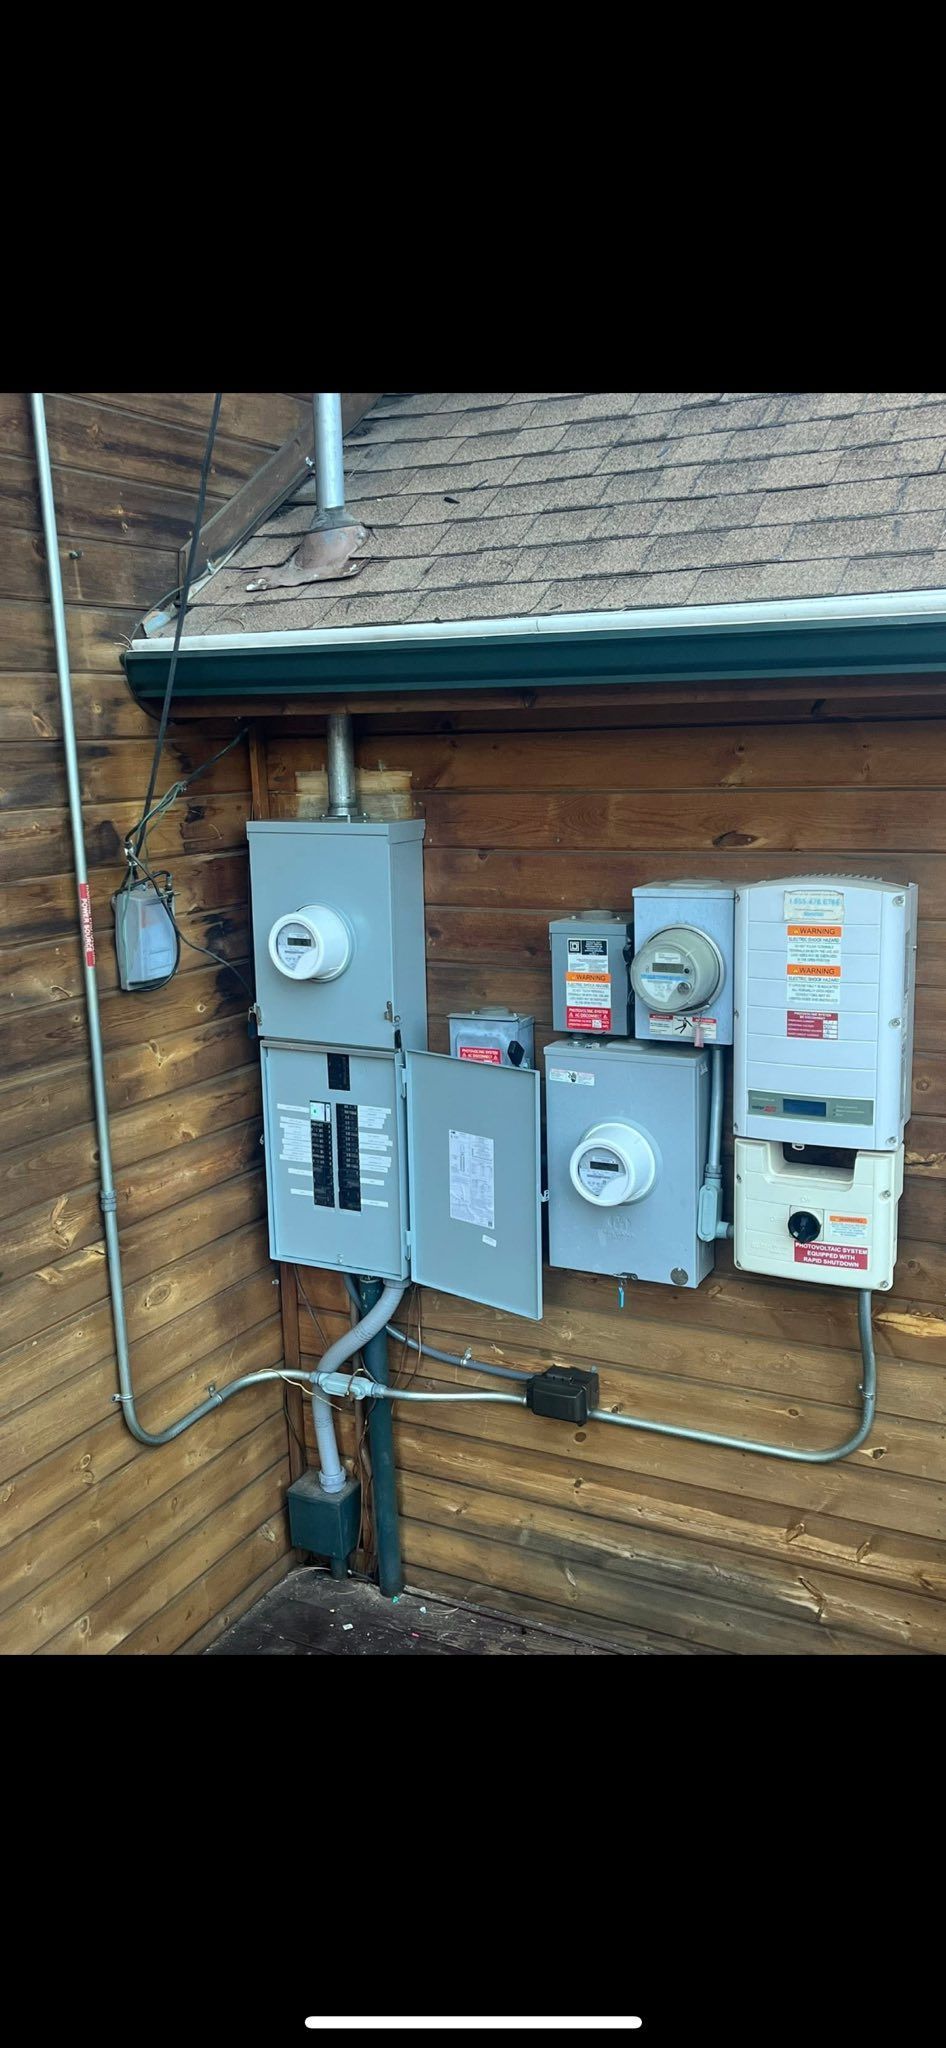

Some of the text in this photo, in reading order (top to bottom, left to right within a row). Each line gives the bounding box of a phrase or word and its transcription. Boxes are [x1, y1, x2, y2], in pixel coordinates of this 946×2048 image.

[81, 898, 89, 923] POWER
[83, 925, 92, 952] SOURCE
[799, 967, 835, 975] WARNING
[795, 1243, 842, 1252] PHOTOVOLTAIC
[807, 1250, 839, 1259] EQUIPPED
[803, 1256, 859, 1267] RAPID SHUTDOWN
